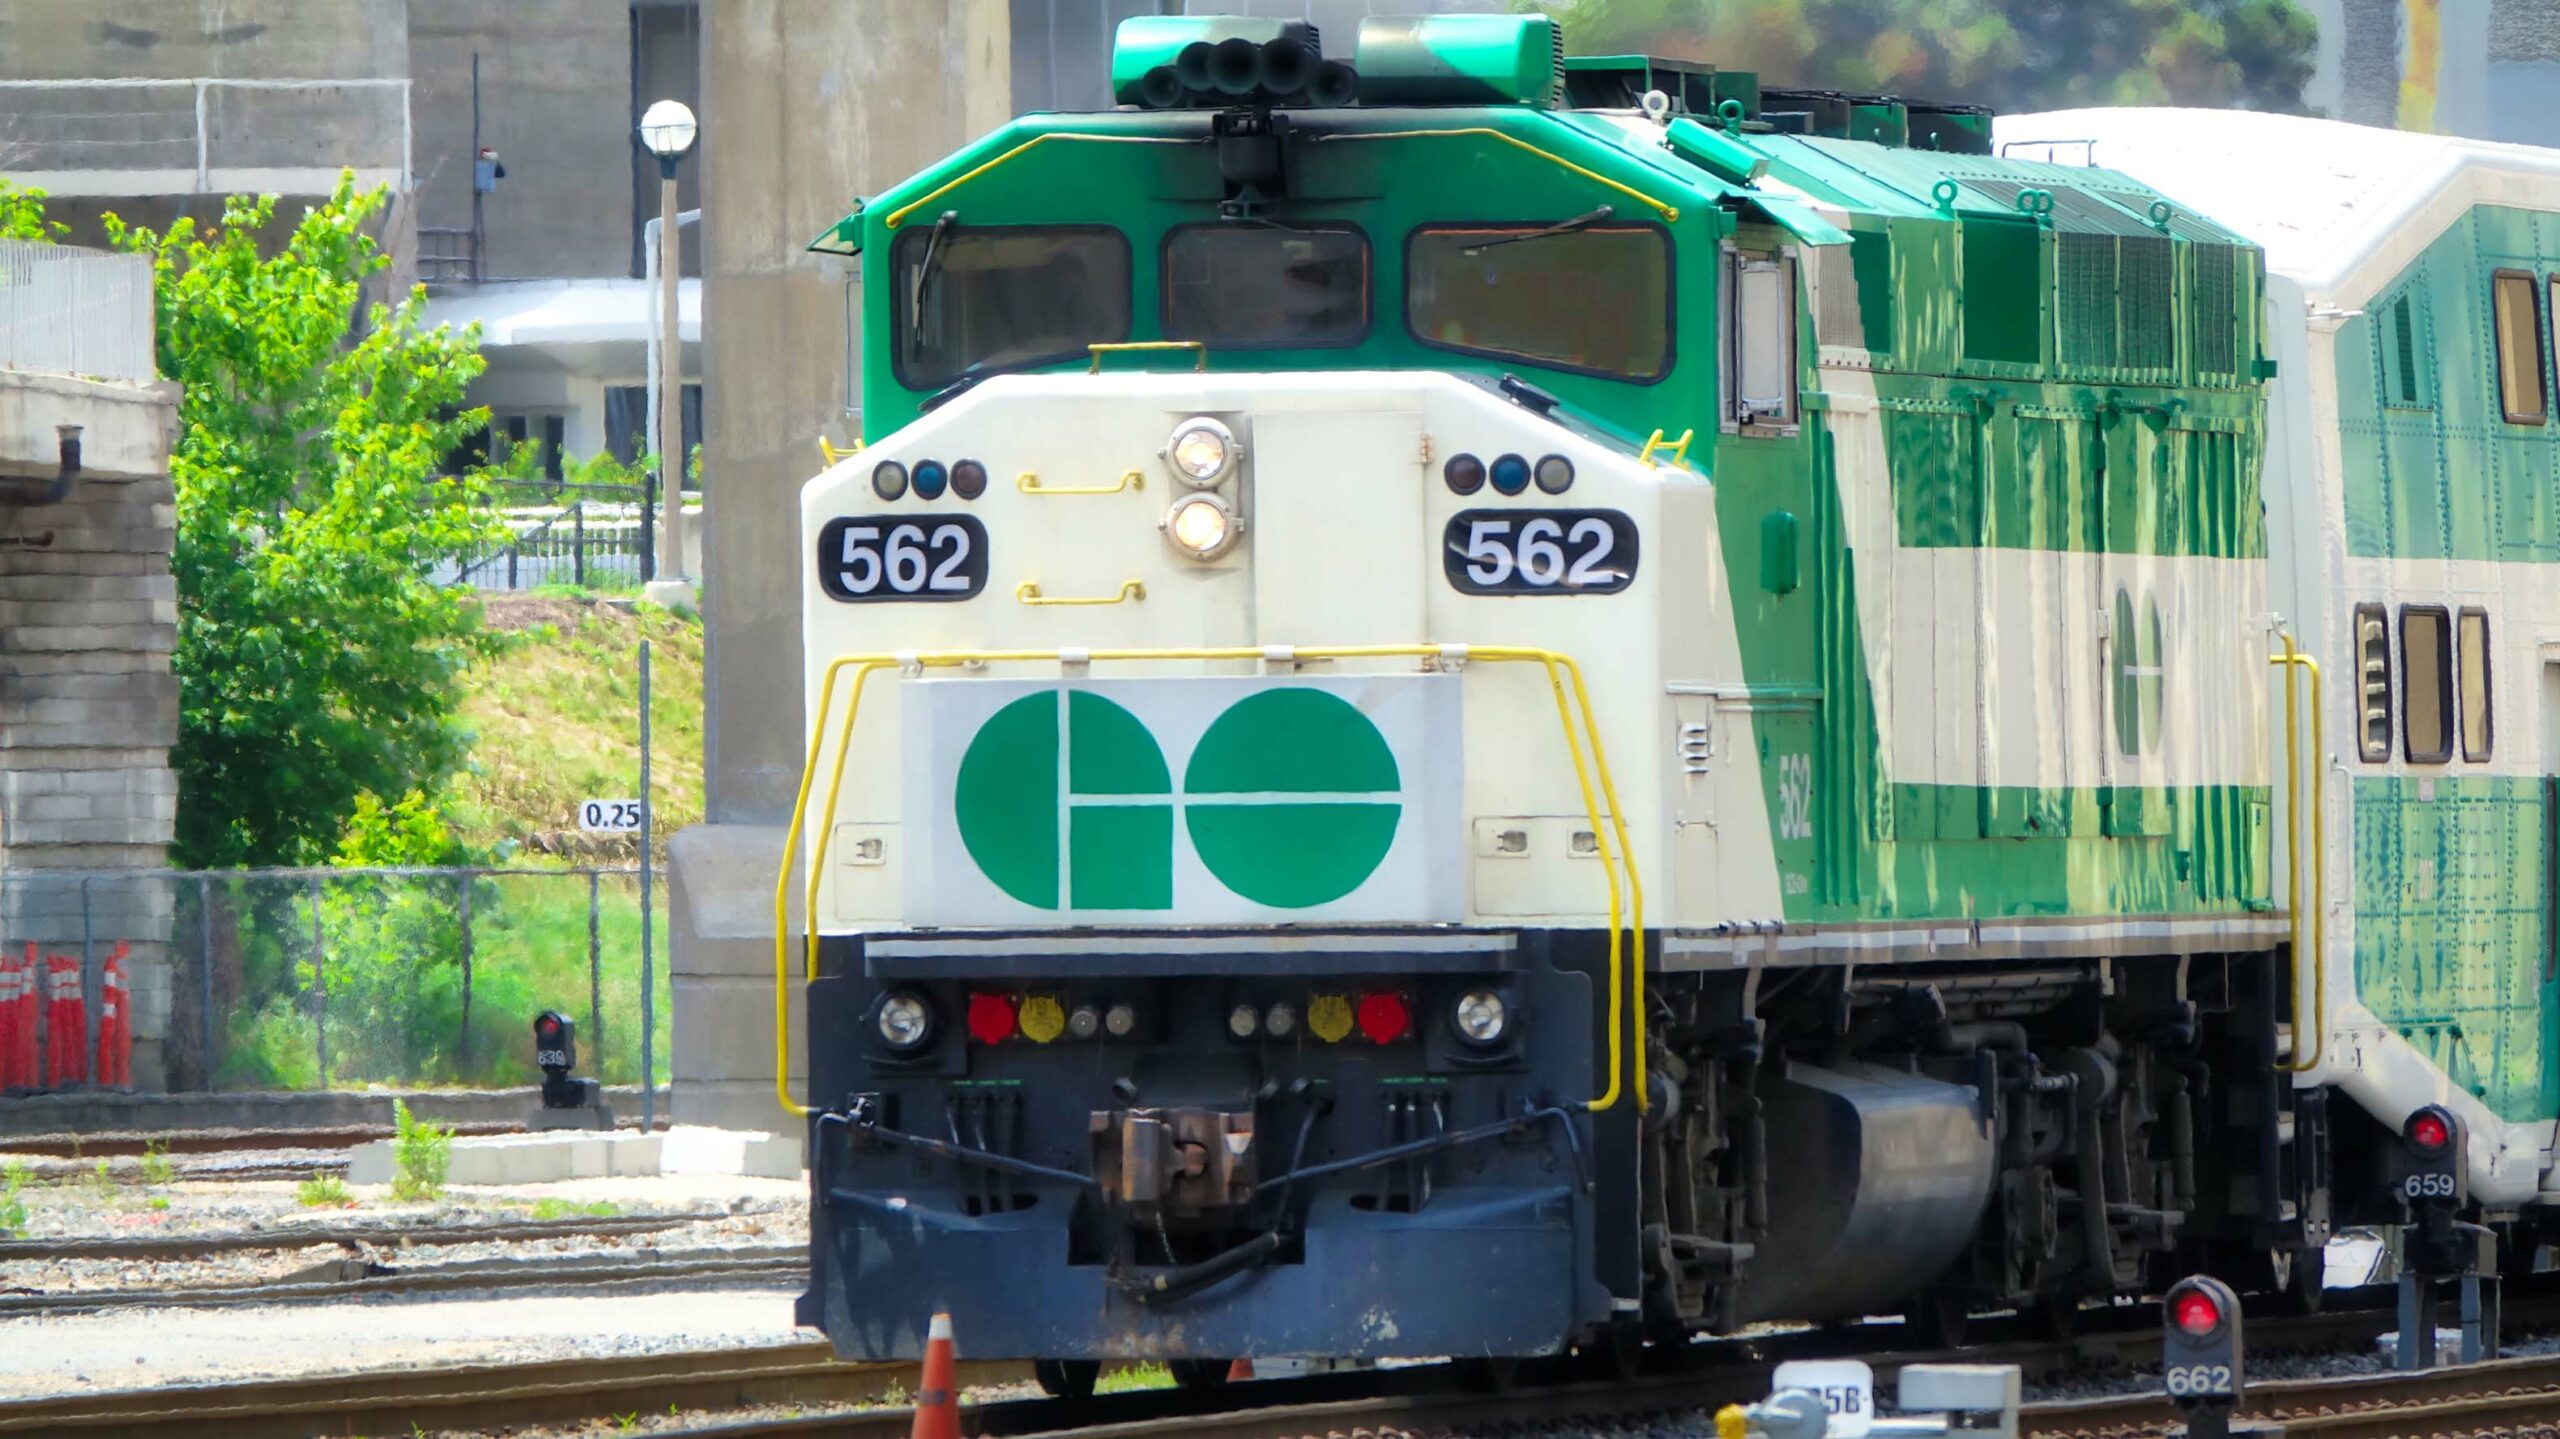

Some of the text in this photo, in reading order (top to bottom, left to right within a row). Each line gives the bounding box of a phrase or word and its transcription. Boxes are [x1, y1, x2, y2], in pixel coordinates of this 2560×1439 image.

[840, 523, 970, 593] 562
[1466, 517, 1614, 586] 562
[586, 803, 640, 828] 0.25
[955, 687, 1402, 910] GO
[1779, 753, 1812, 839] 562
[537, 1049, 567, 1067] 639
[2404, 1173, 2455, 1197] 659
[2166, 1364, 2232, 1396] 662
